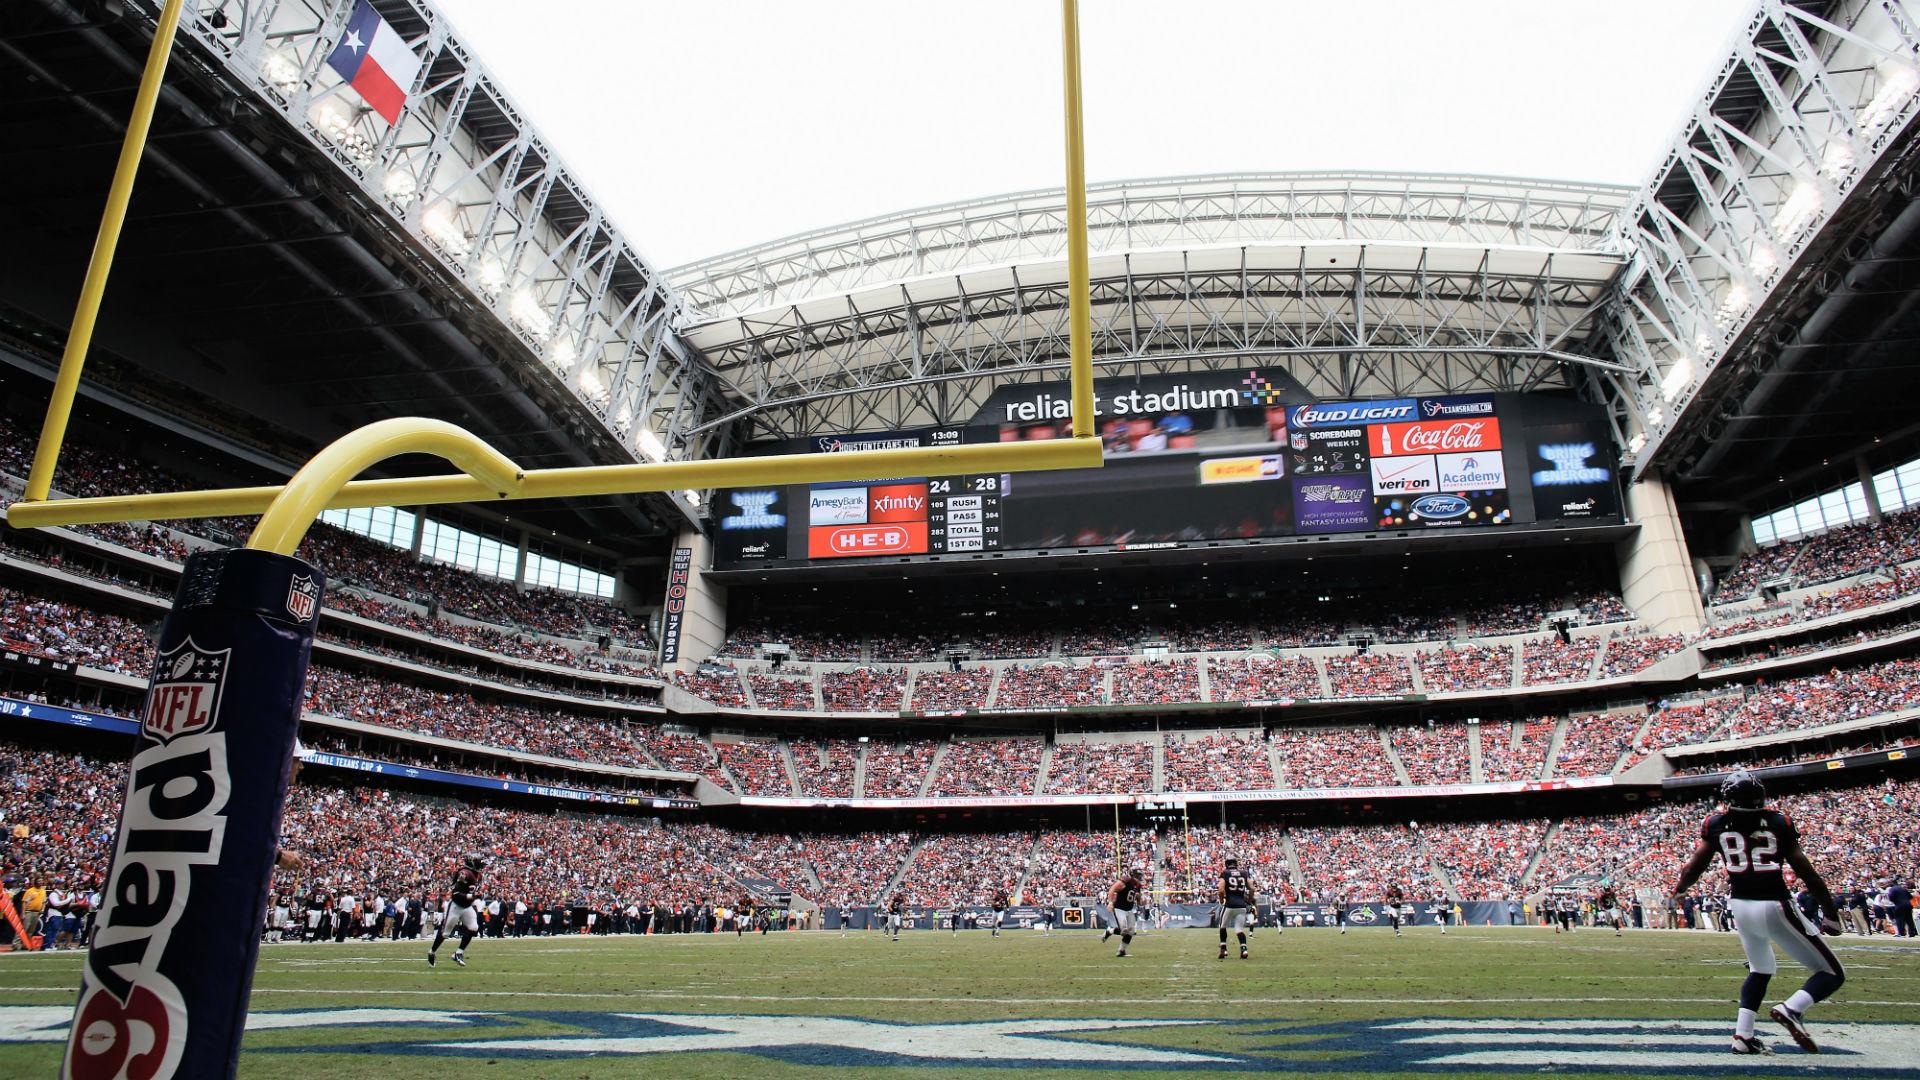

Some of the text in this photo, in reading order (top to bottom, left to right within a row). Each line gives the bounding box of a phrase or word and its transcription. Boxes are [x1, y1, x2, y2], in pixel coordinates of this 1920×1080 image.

[1006, 385, 1239, 421] reliat stadium
[1441, 402, 1492, 414] TEXANSRADIO.COM
[1301, 407, 1412, 422] BUD LIGHT
[931, 431, 958, 440] 13:09
[1309, 430, 1361, 440] SCOREBOARD
[1402, 421, 1486, 451] Coca-Cola
[975, 477, 997, 491] 28
[1379, 478, 1430, 491] verizon
[1443, 472, 1500, 485] Academy
[929, 480, 951, 493] 24
[952, 499, 977, 507] RUSH
[1425, 501, 1457, 513] Ford
[951, 526, 980, 534] TOTAL
[4, 652, 19, 661] DOWN
[145, 681, 207, 734] NFL
[335, 756, 360, 769] TEXANS
[360, 761, 374, 771] CUP
[536, 786, 549, 795] FREE
[549, 788, 581, 800] COLLECTABLE
[1719, 831, 1780, 873] 82
[1228, 877, 1246, 891] 93
[1065, 911, 1081, 923] 25
